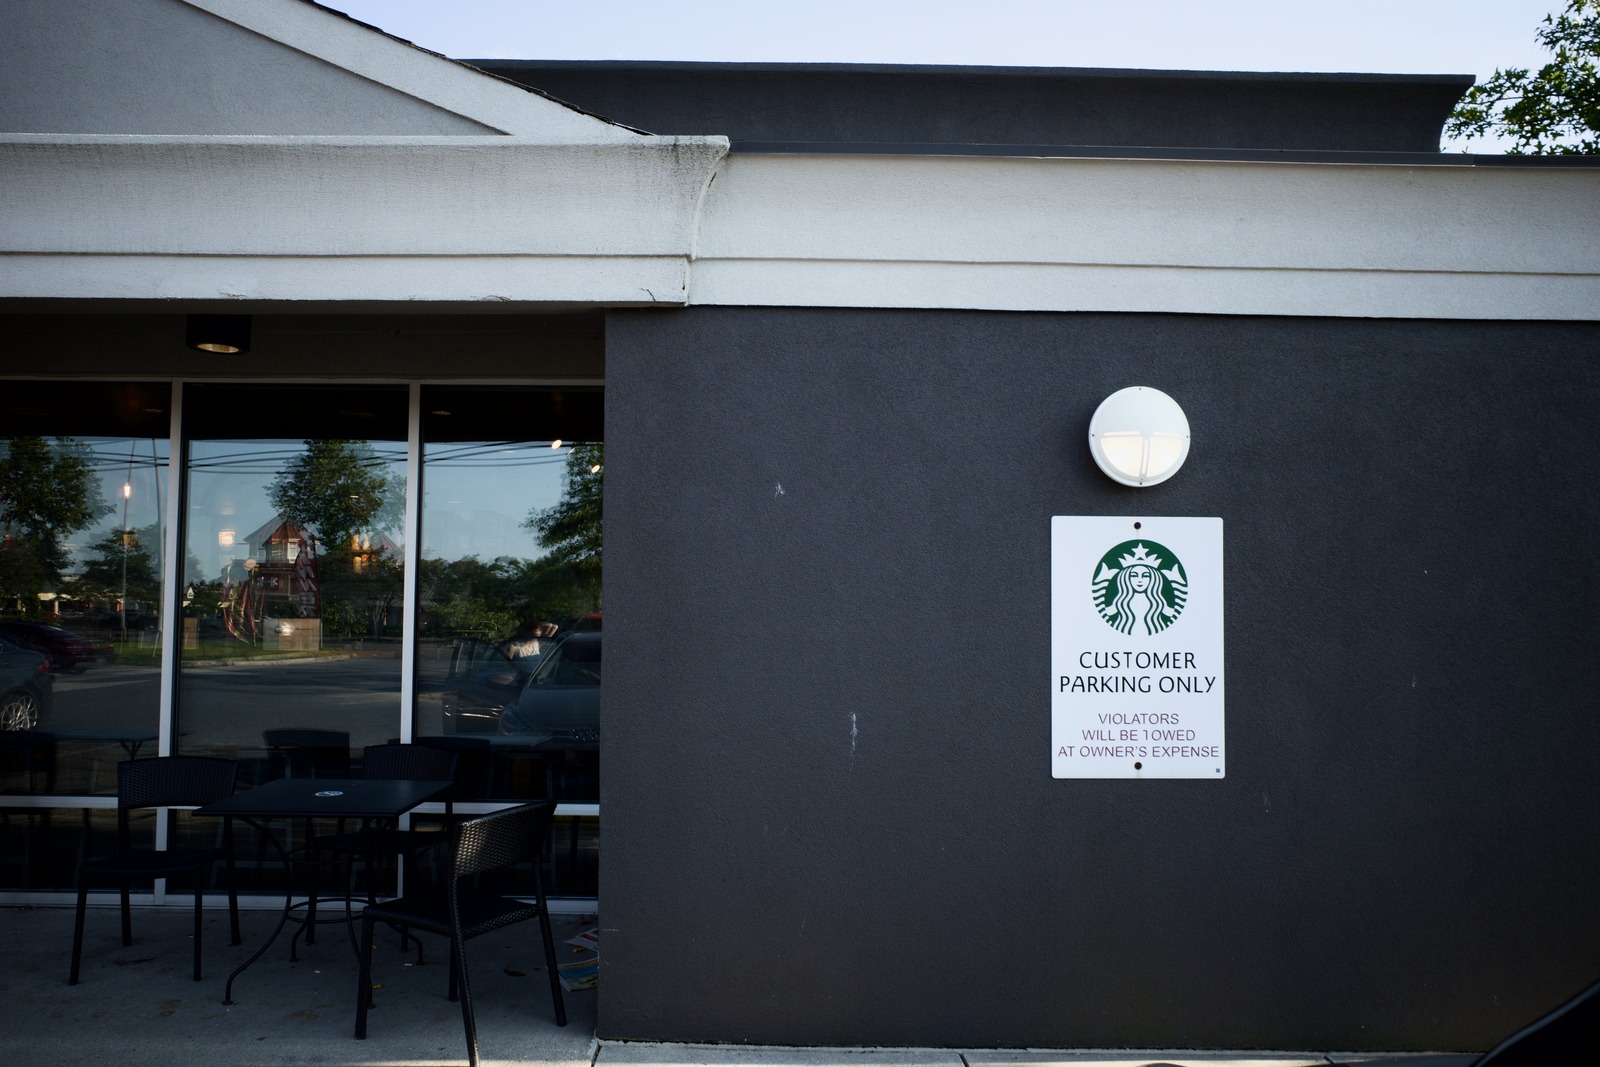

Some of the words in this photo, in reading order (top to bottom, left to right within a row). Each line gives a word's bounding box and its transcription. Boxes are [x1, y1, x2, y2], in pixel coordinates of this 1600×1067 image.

[1080, 652, 1196, 669] CUSTOMER
[1060, 676, 1151, 693] PARKING
[1159, 676, 1216, 693] ONLY
[1098, 713, 1179, 724] VIOLATORS
[1082, 730, 1115, 741] WILL
[1120, 730, 1138, 741] BE
[1058, 746, 1075, 757] AT
[1080, 746, 1147, 757] OWNER'S
[1153, 746, 1219, 757] EXPENSE
